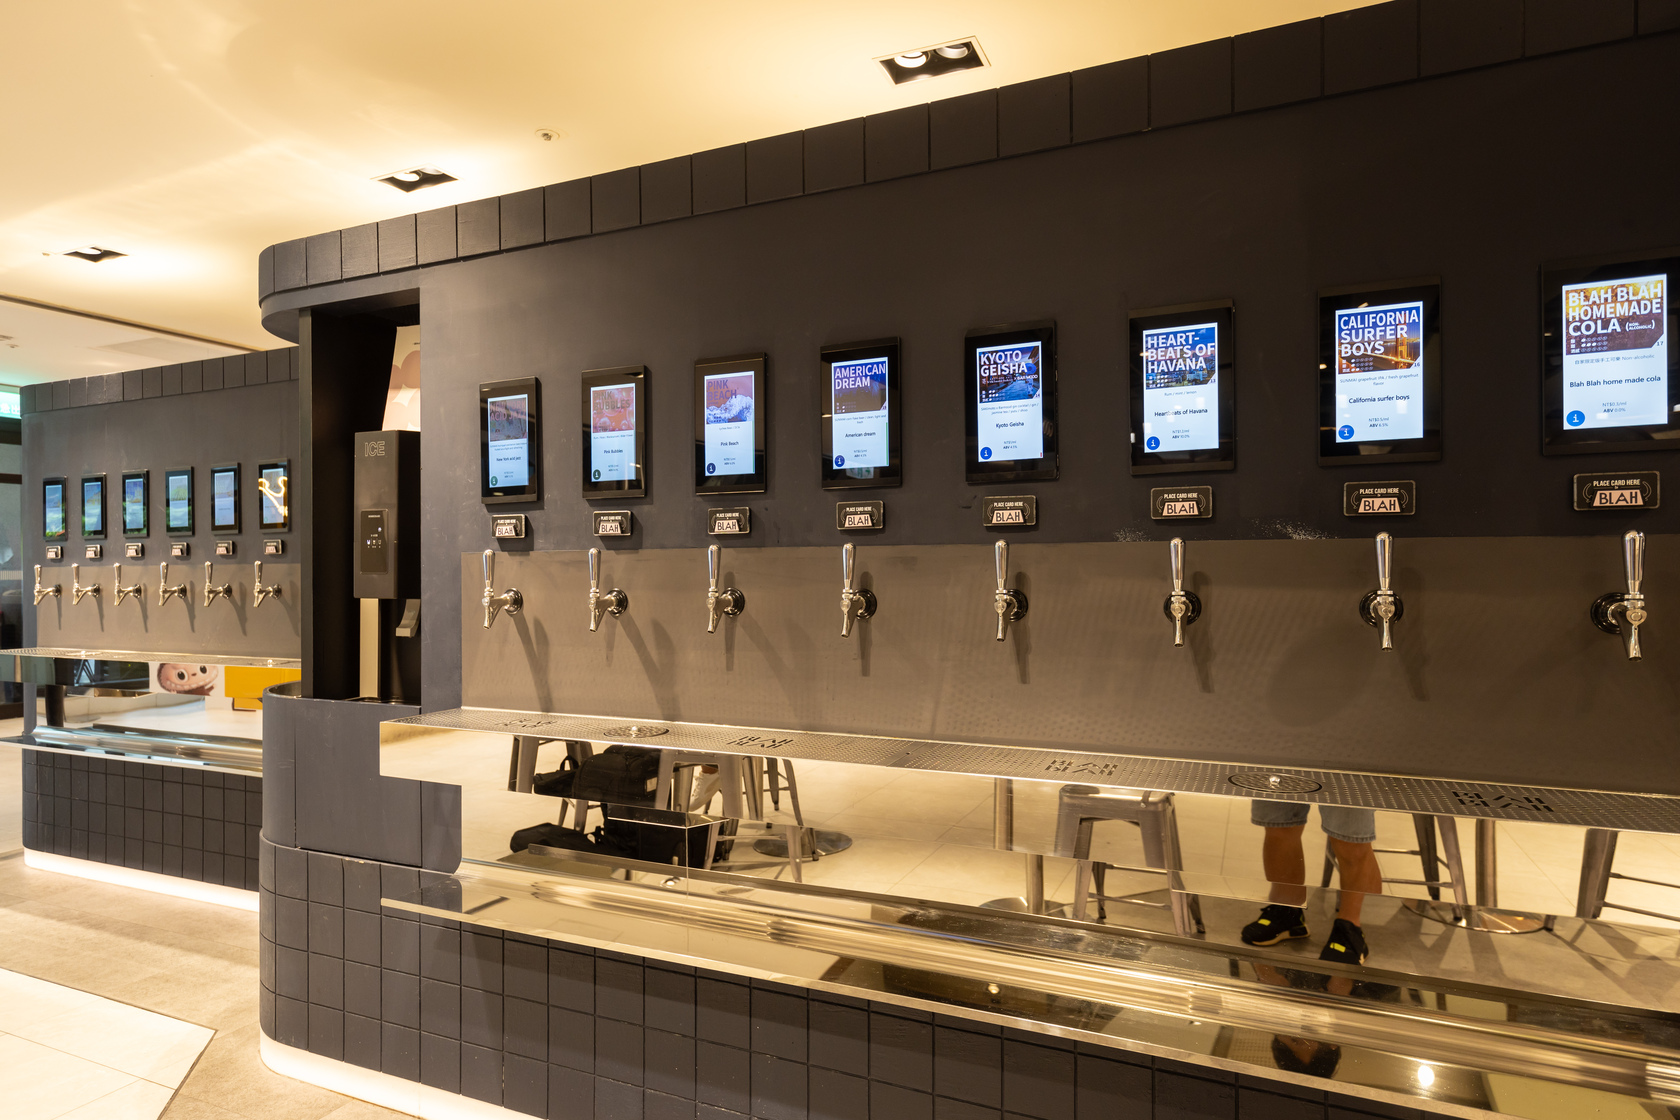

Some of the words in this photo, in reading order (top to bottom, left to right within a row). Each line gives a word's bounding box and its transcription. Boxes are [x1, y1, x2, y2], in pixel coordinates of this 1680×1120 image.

[1568, 288, 1611, 306] BLAH
[1617, 282, 1662, 302] BLAH
[1568, 299, 1662, 321] HOMEMADE
[1340, 310, 1419, 330] CALIFORNIA
[1569, 318, 1621, 336] COLA
[1147, 332, 1200, 349] HEART-
[1340, 325, 1408, 343] SURFER
[1148, 346, 1192, 360] BEATS
[1196, 343, 1215, 356] OF
[1341, 341, 1385, 358] BOYS
[980, 350, 1022, 365] KYOTO
[835, 364, 886, 379] AMERICAN
[981, 362, 1028, 377] GEISHA
[1148, 357, 1206, 374] HAVANA
[708, 380, 728, 391] PINK
[835, 376, 870, 389] DREAM
[593, 391, 612, 400] PINK
[708, 389, 737, 401] BEACH
[594, 399, 630, 410] BUBBLES
[490, 411, 507, 421] ACID
[364, 441, 385, 456] ICE
[1364, 500, 1395, 511] BLAH
[1599, 492, 1638, 505] BLAH
[1167, 503, 1194, 514] BLAH
[848, 516, 869, 525] BLAH
[996, 512, 1020, 522] BLAH
[601, 524, 618, 532] BLAH
[718, 521, 736, 530] BLAH
